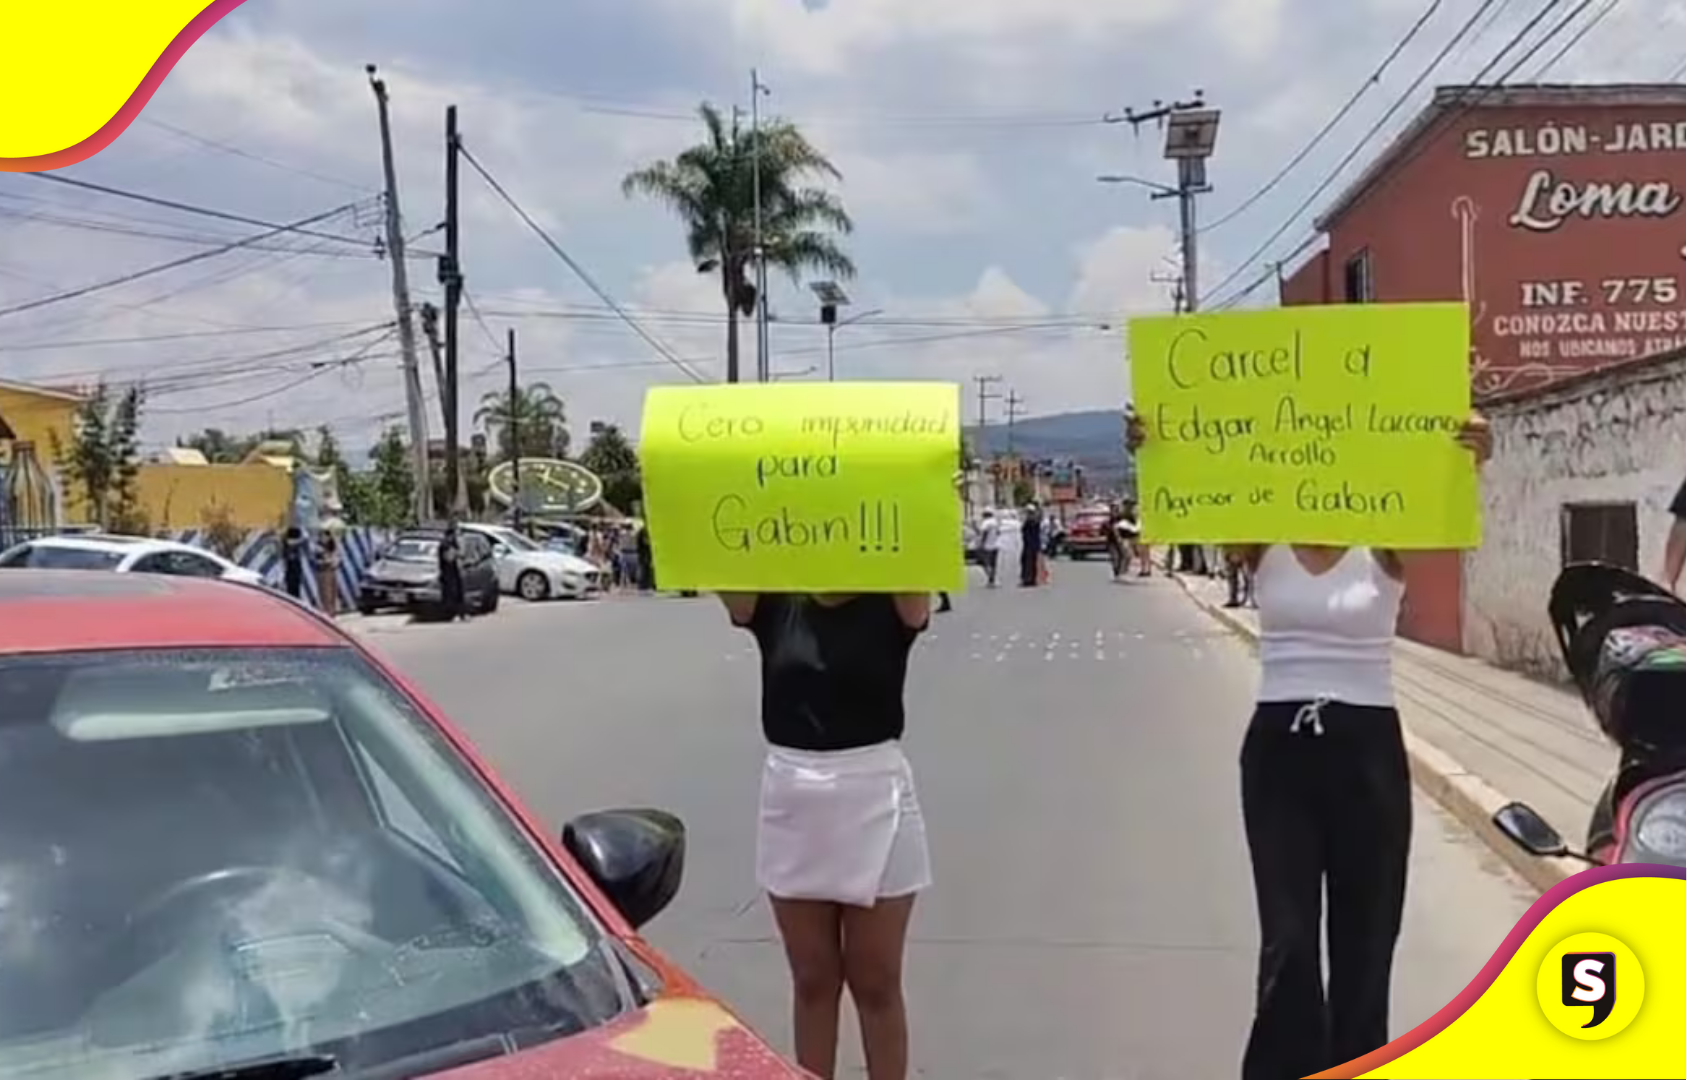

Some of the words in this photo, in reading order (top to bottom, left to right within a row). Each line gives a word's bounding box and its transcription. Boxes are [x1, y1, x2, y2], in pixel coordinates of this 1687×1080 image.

[1510, 170, 1680, 229] Loma
[1521, 281, 1588, 305] INF.
[1602, 278, 1677, 302] 775
[1493, 312, 1605, 336] CONOZCA
[1168, 329, 1302, 389] Carcel
[1344, 344, 1370, 376] a
[678, 402, 764, 443] Cero
[1156, 404, 1255, 454] Edgar
[1249, 441, 1336, 466] Arrollo
[757, 454, 836, 488] para
[1155, 486, 1232, 518] Agresor
